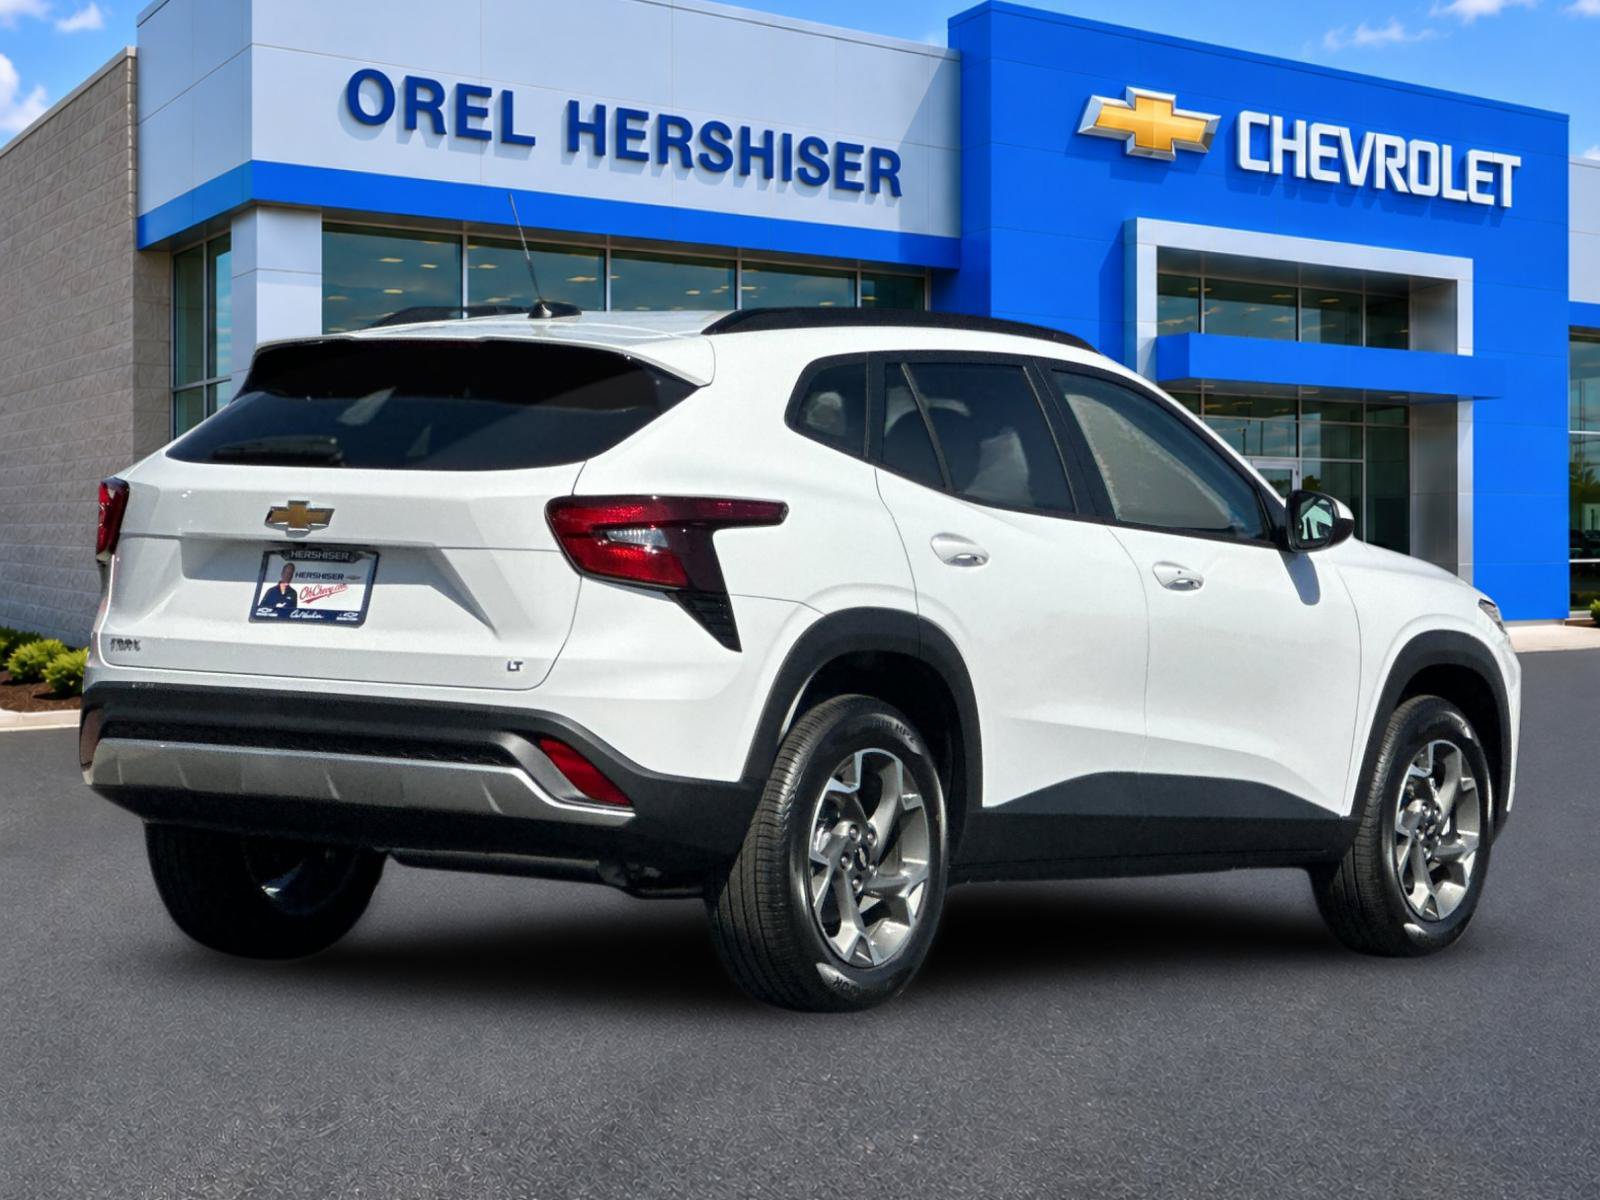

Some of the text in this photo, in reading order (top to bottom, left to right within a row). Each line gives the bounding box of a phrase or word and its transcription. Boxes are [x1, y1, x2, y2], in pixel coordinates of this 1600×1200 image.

[346, 68, 903, 198] OREL HERSHISER
[1238, 110, 1522, 208] CHEVROLET
[290, 550, 350, 560] HERSHISER
[295, 571, 344, 580] HERSHISER
[507, 660, 523, 672] LT
